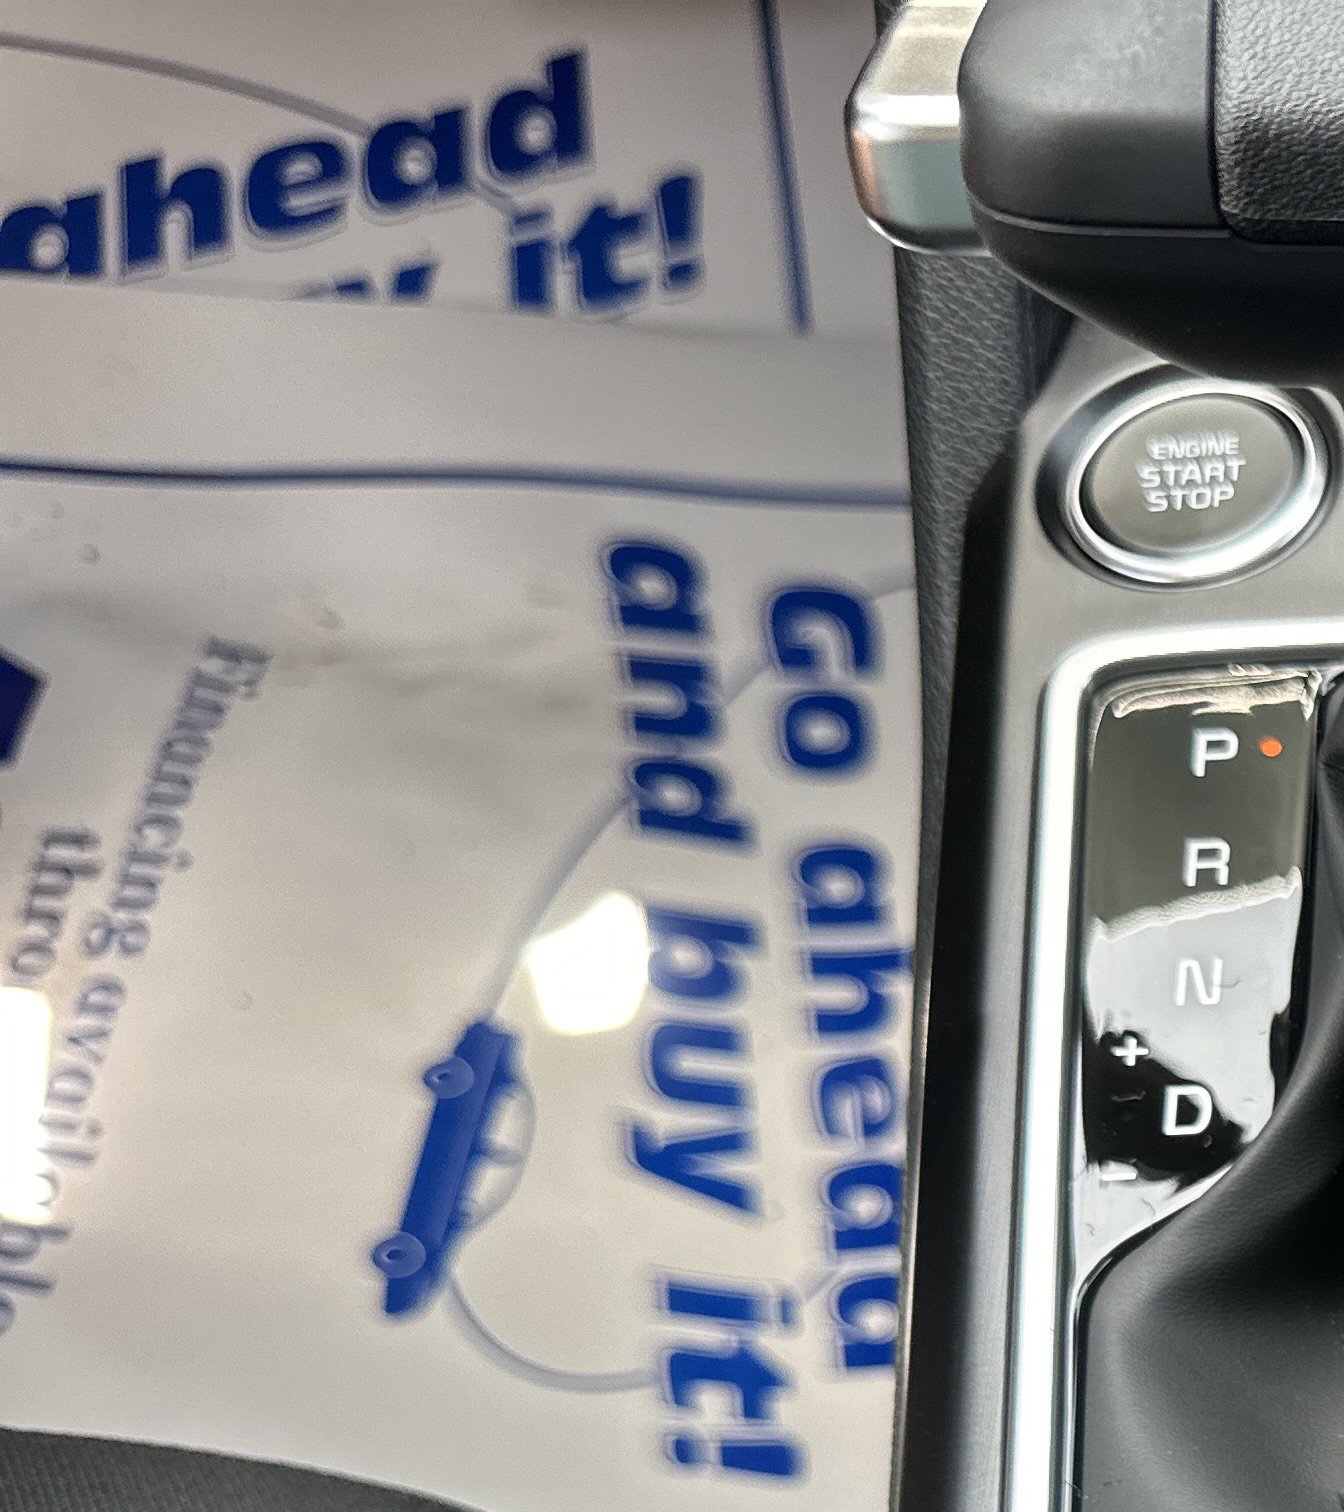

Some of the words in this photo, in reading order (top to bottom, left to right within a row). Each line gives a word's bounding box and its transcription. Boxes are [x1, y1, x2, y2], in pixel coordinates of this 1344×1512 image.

[0, 50, 590, 280] ahead
[506, 172, 702, 312] it!
[1137, 457, 1246, 488] START
[1144, 482, 1235, 513] STOP
[1147, 434, 1240, 460] ENGINE
[606, 541, 748, 848] and
[770, 585, 876, 775] Go
[1190, 727, 1240, 778] P
[82, 635, 272, 958] Financing
[1181, 837, 1231, 887] R
[8, 826, 104, 978] thro
[1175, 957, 1223, 1007] N
[629, 906, 760, 1215] buy
[798, 842, 912, 1375] ahead
[1162, 1083, 1213, 1136] D
[0, 973, 128, 1338] availbl
[662, 1279, 802, 1482] it!
